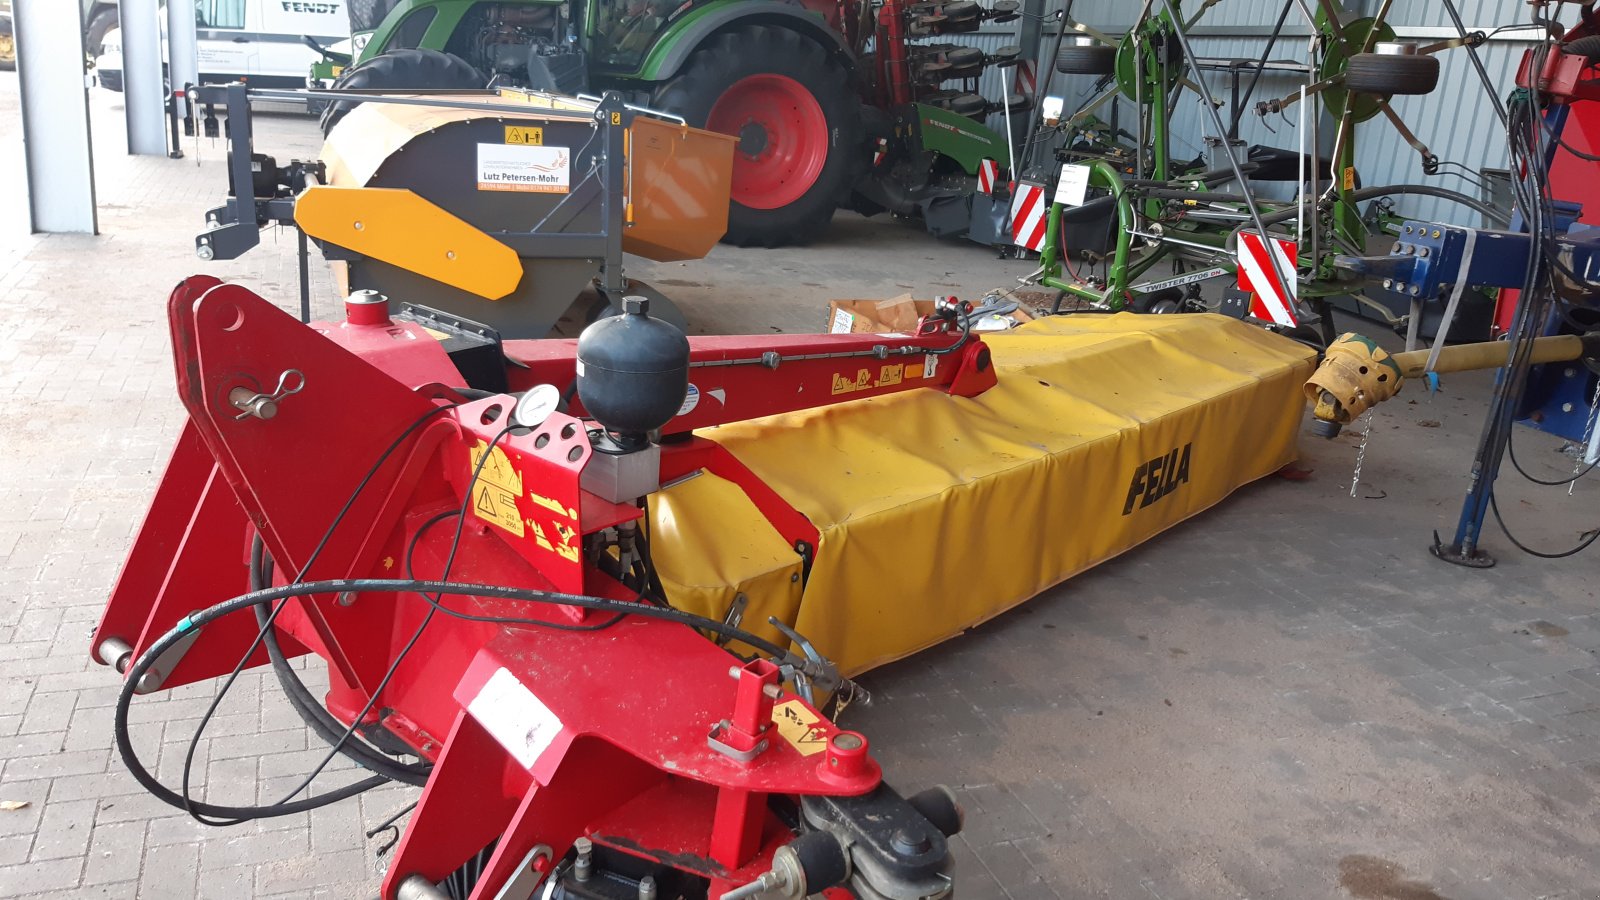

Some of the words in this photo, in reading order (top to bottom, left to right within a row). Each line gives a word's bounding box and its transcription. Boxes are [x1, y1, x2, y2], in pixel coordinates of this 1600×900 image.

[281, 1, 340, 14] FENDT
[483, 171, 500, 180] Lutz
[502, 172, 559, 183] Petersen-Mohr
[1146, 278, 1185, 292] TWISTER
[1187, 272, 1209, 282] 7706
[1122, 442, 1192, 516] FELLA
